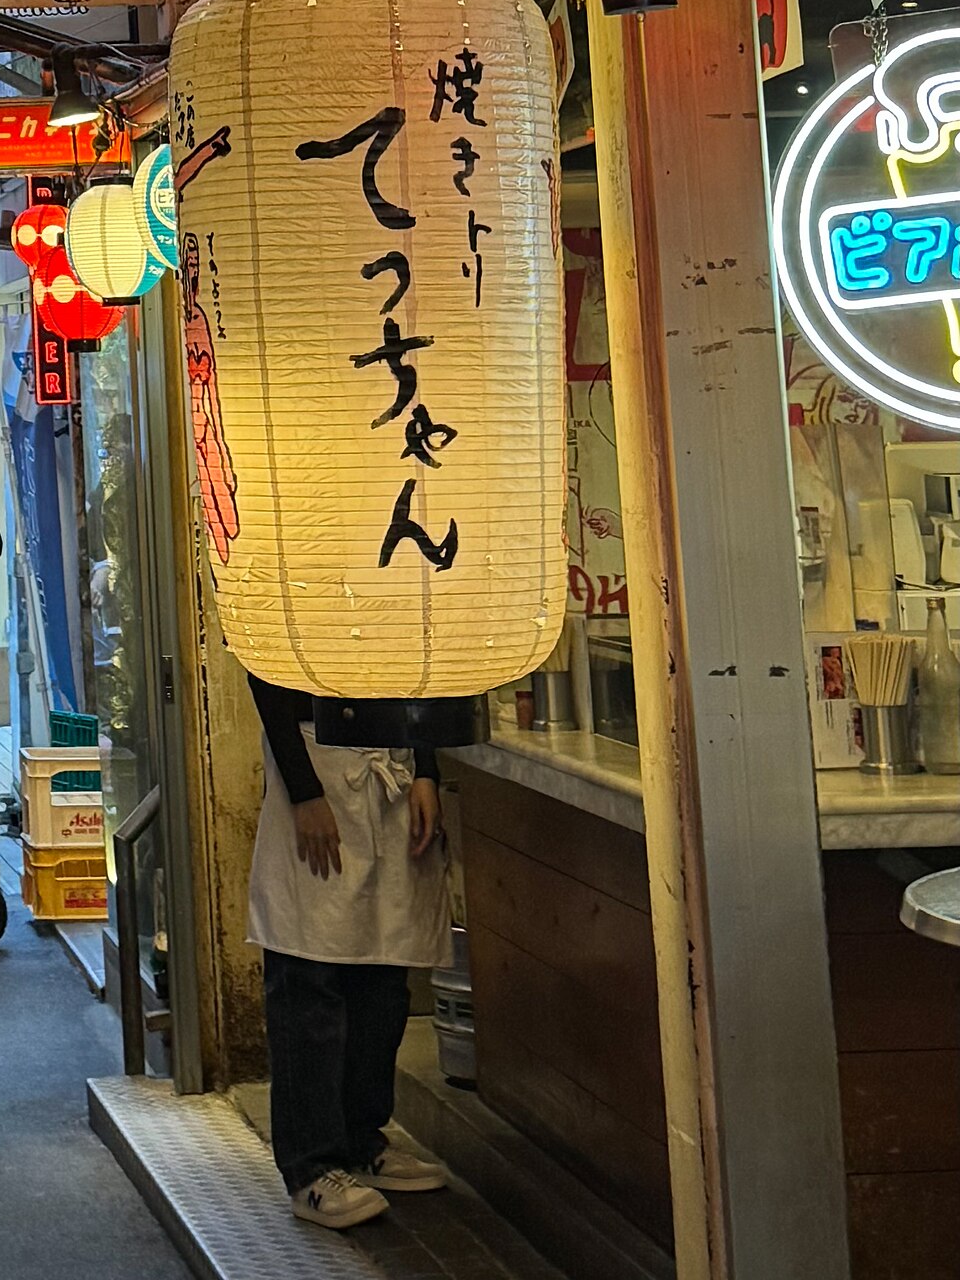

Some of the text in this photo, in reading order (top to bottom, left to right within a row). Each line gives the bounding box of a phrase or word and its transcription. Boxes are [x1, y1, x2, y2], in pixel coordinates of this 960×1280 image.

[296, 108, 460, 573] てっちゃん
[830, 210, 960, 291] ビア
